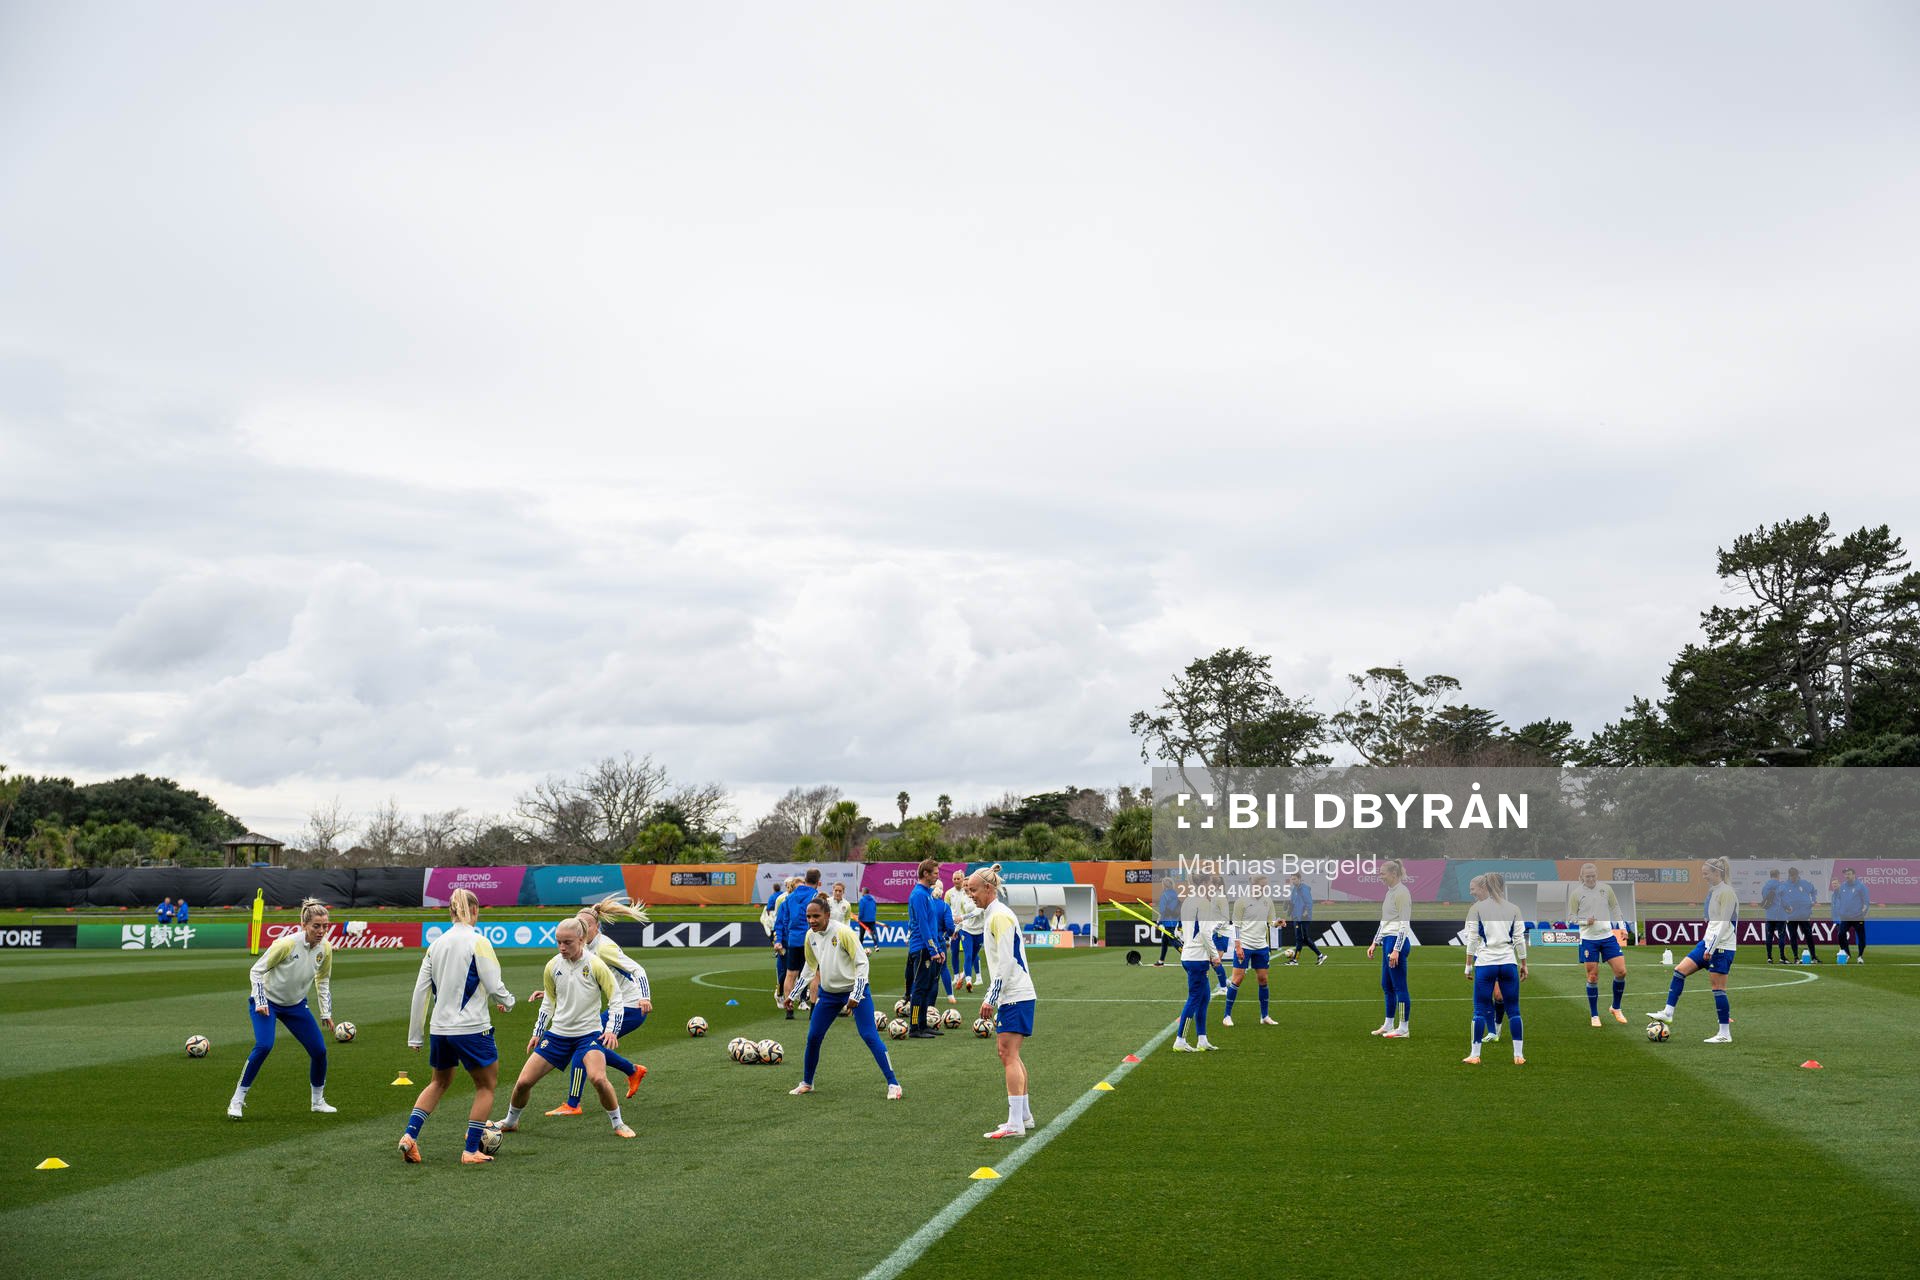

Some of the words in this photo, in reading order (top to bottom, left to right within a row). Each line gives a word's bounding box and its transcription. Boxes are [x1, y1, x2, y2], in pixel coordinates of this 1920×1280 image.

[1866, 867, 1909, 876] BEYOND
[457, 873, 491, 881] BEYOND
[557, 875, 603, 884] #FIFAWWC
[1002, 873, 1053, 881] #FIFAWWC
[448, 882, 498, 890] GREATNESS
[150, 925, 196, 949] 蒙牛
[642, 922, 742, 948] KIA
[1651, 922, 1704, 944] QAT
